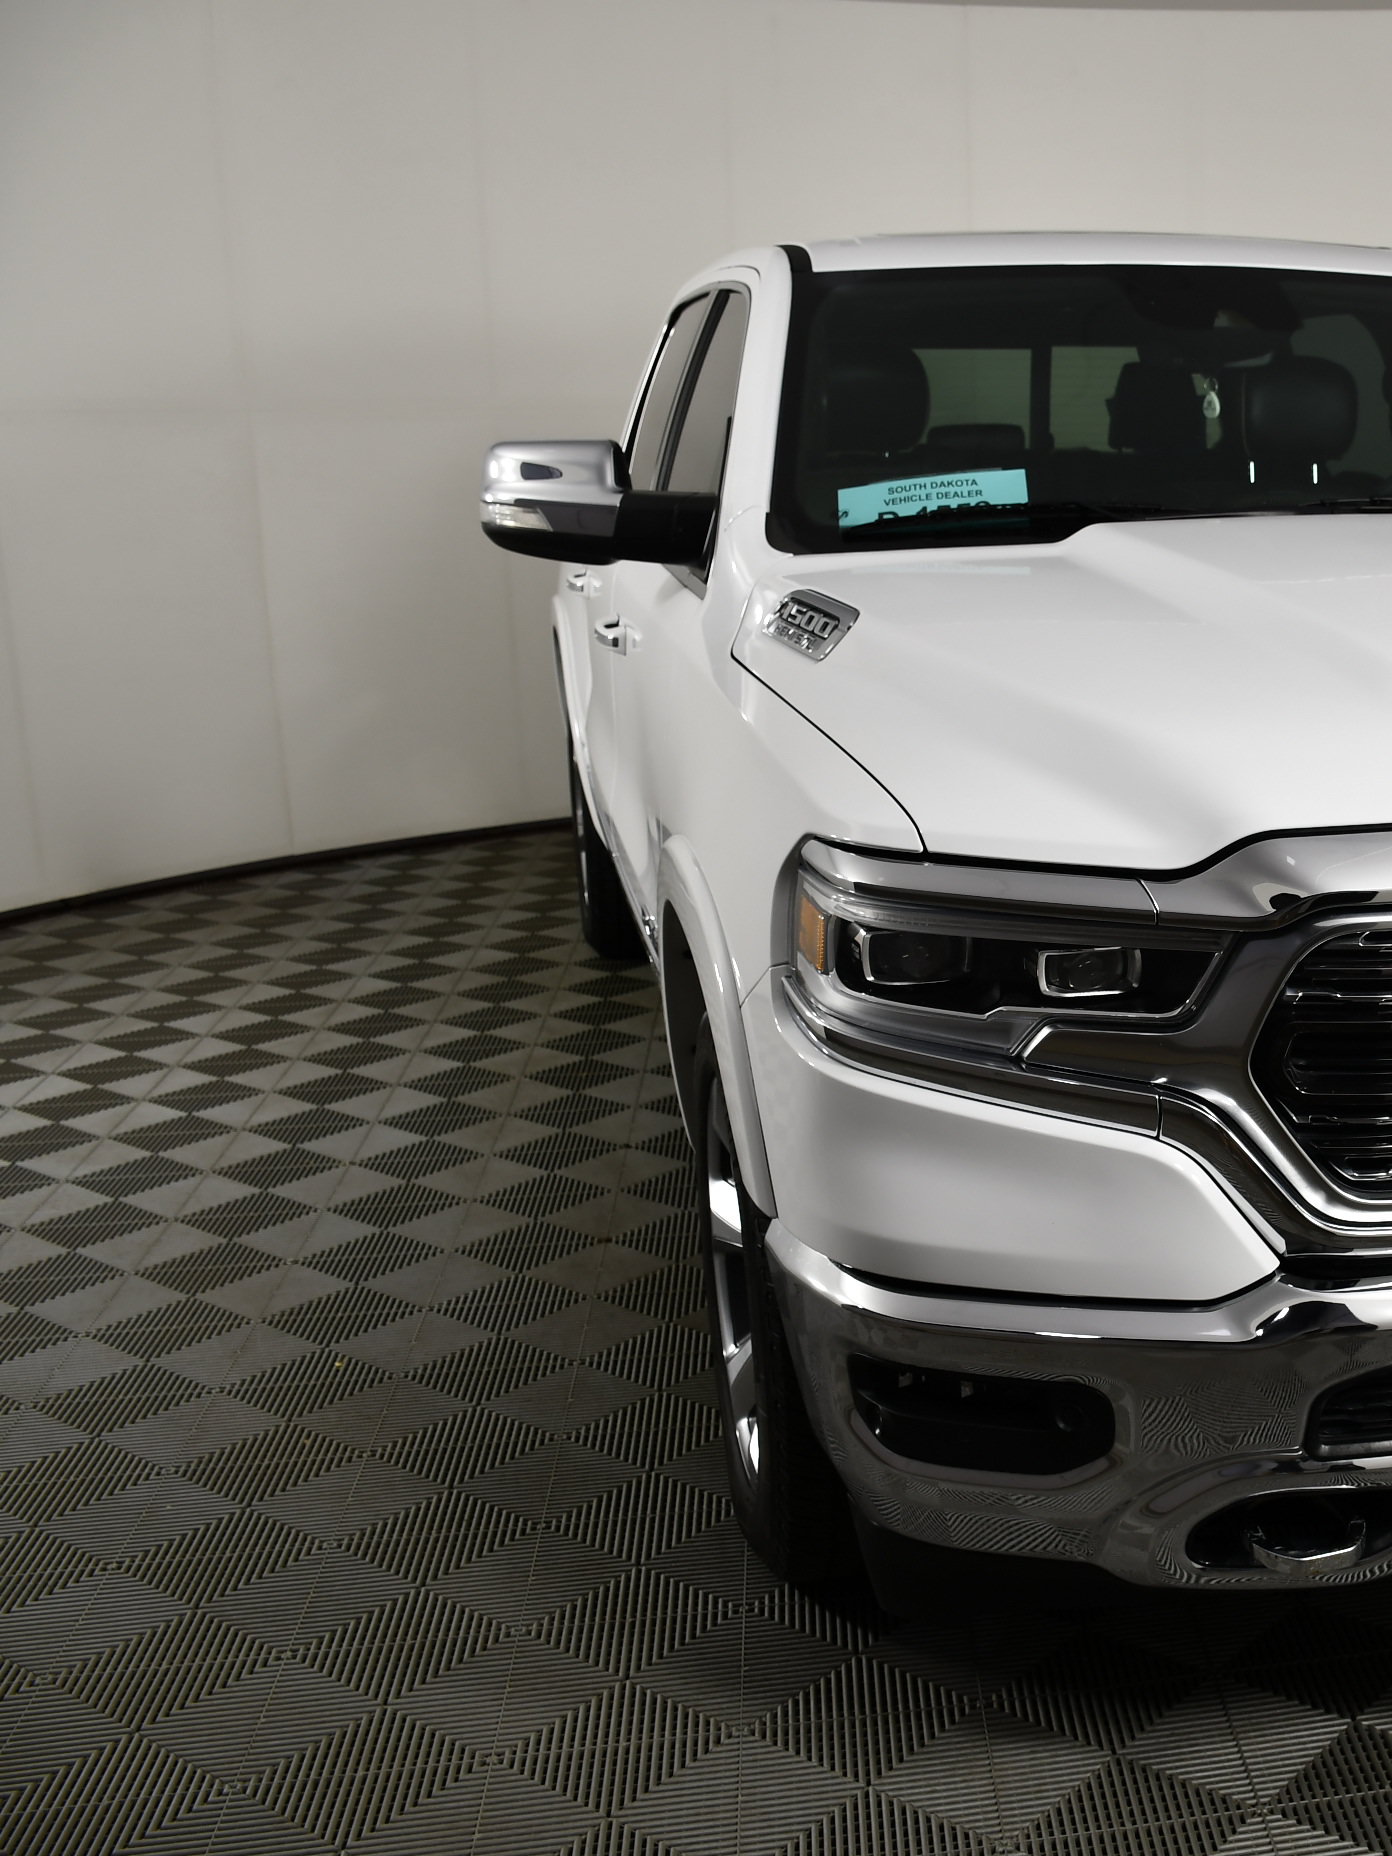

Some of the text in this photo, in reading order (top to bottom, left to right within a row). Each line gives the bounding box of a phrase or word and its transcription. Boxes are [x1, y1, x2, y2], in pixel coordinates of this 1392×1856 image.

[888, 478, 979, 495] SOUTH DAKOTA
[884, 489, 984, 506] VEHICLE DEALER
[780, 601, 838, 639] 1500
